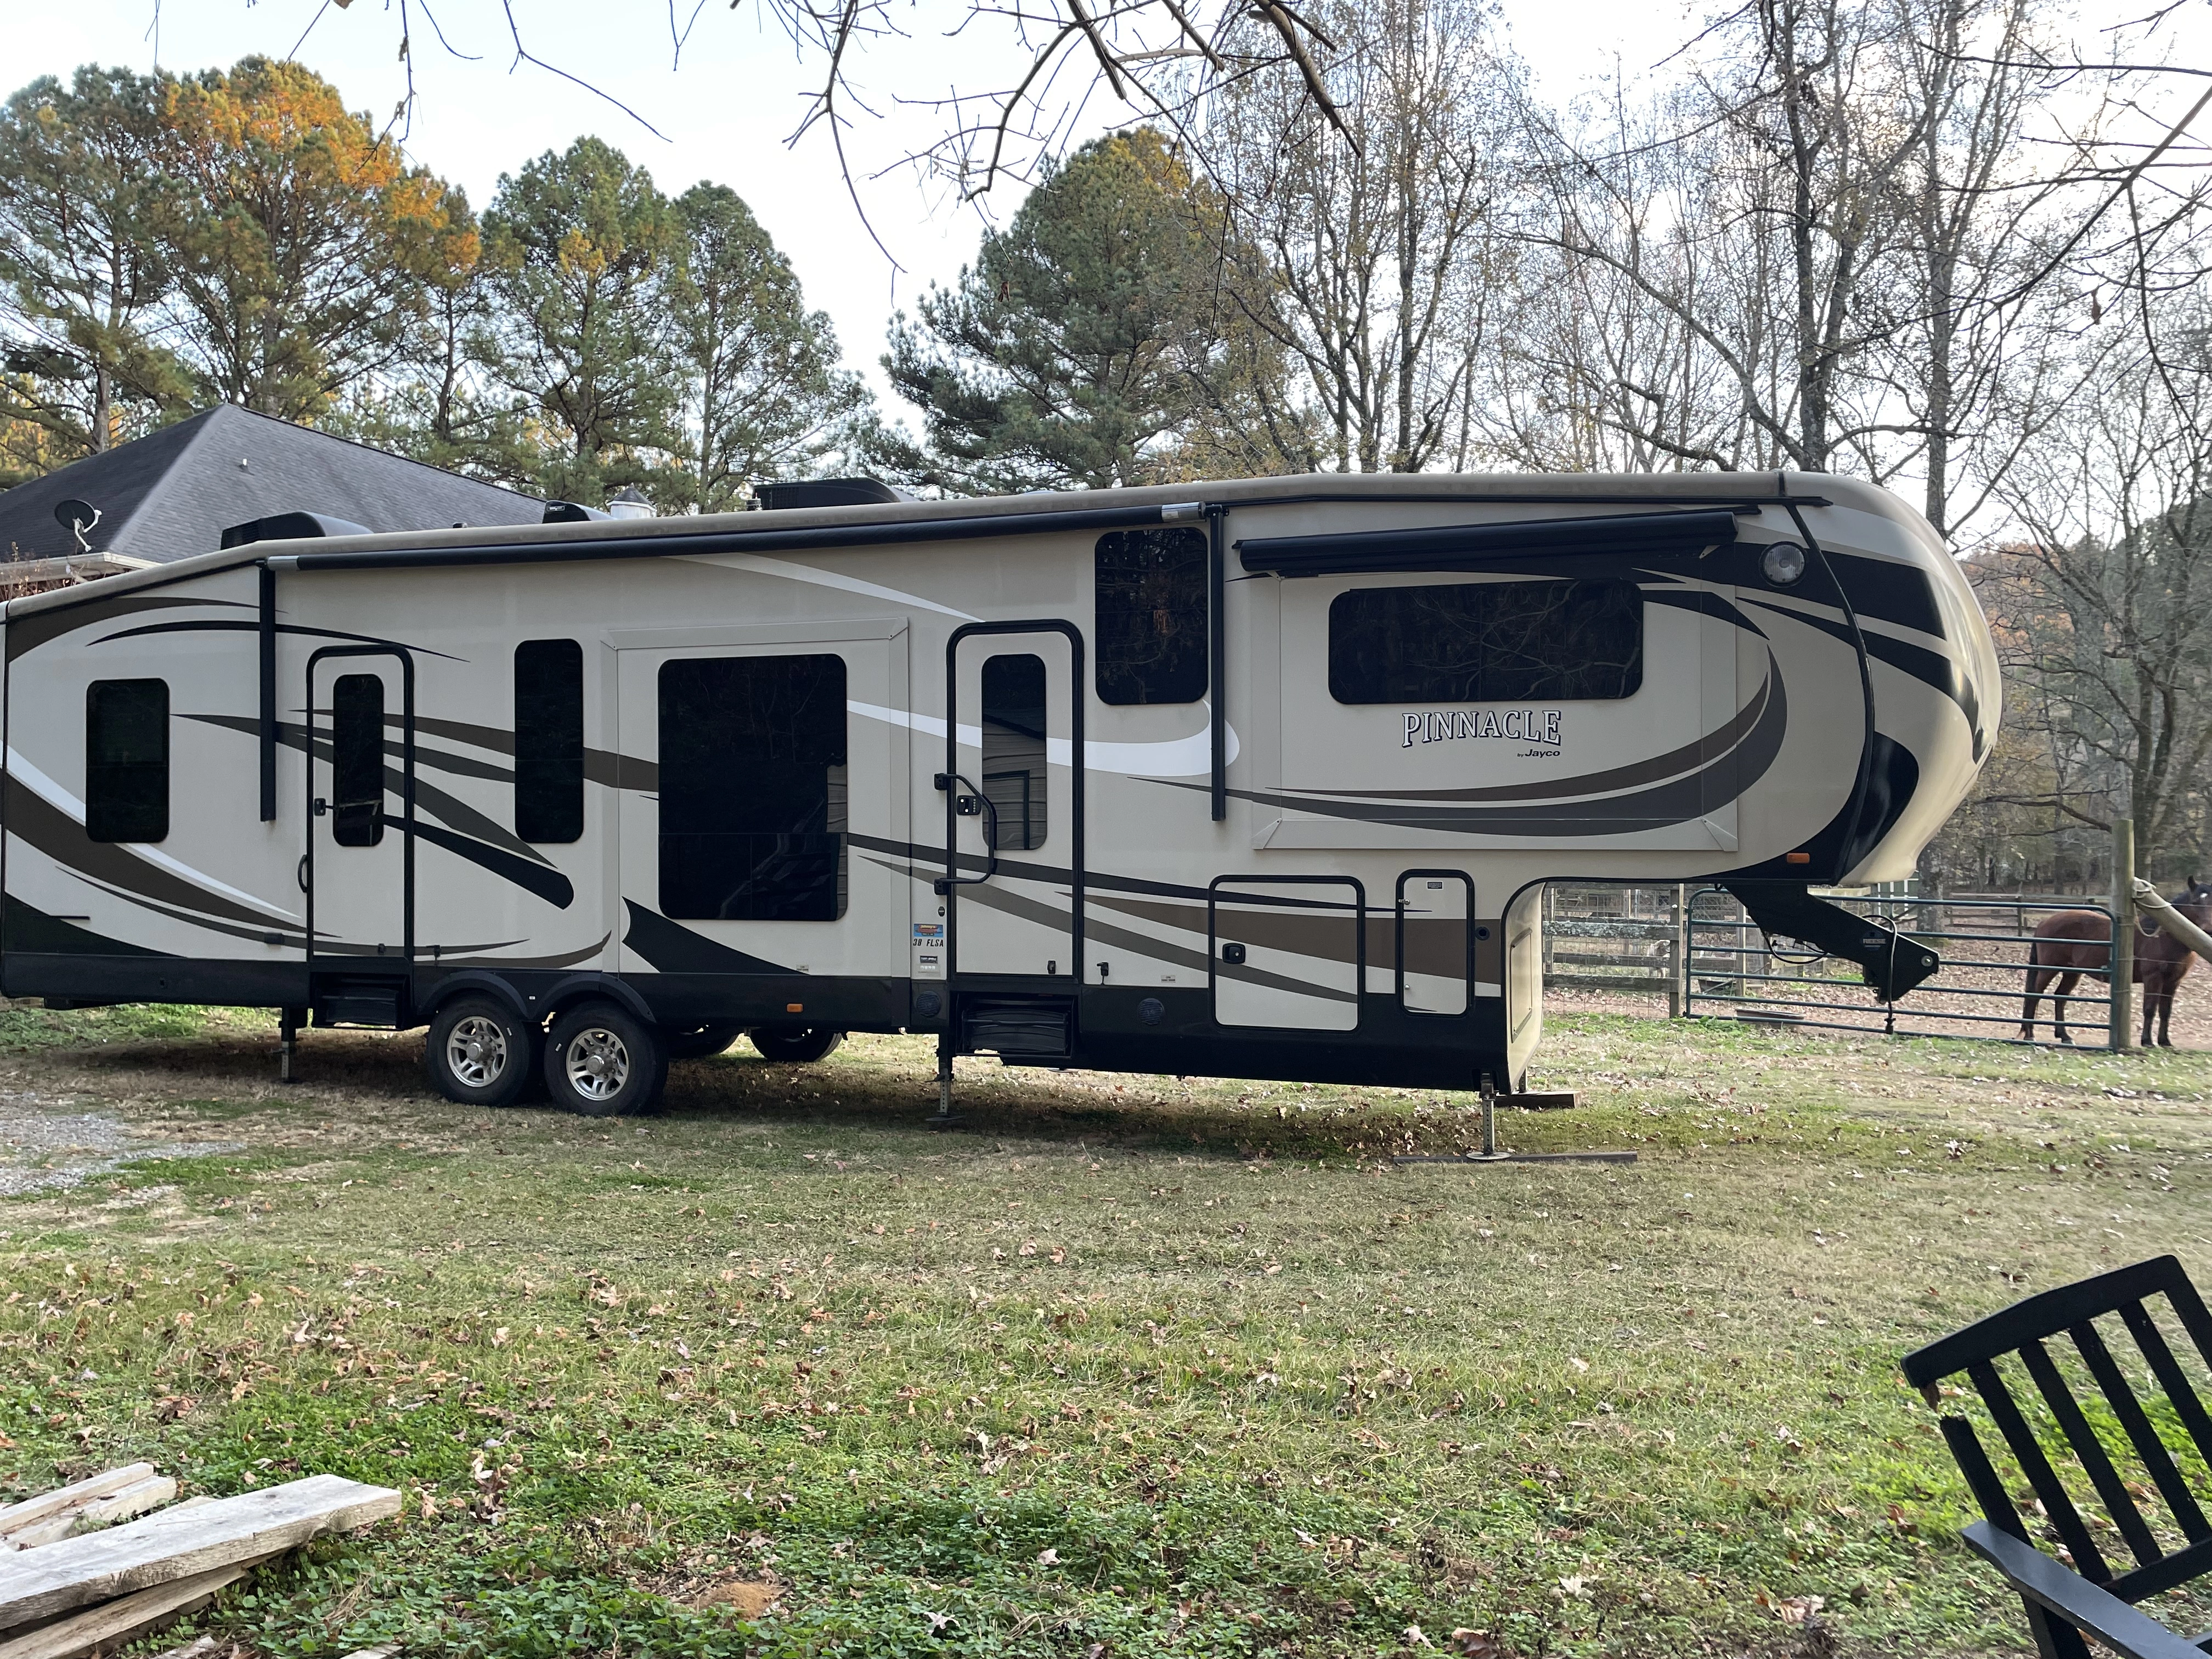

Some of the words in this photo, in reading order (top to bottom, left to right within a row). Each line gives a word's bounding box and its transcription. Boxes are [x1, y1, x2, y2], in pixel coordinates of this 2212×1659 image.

[1402, 710, 1561, 748] PINNACLE
[1525, 749, 1561, 758] Jayco
[926, 939, 944, 947] FLSA
